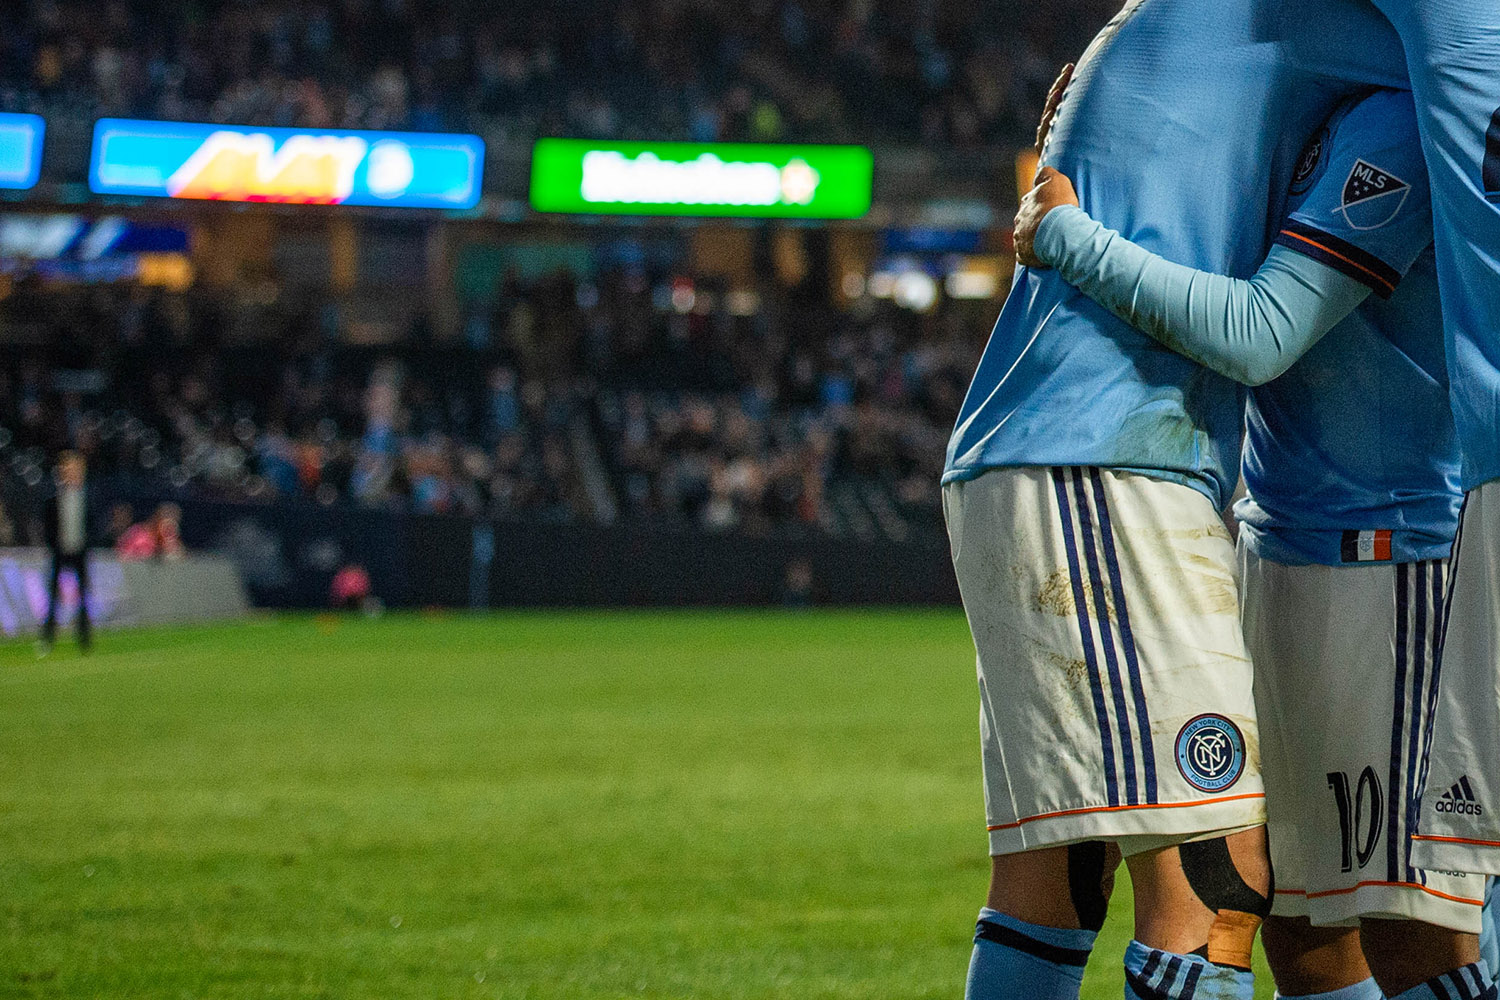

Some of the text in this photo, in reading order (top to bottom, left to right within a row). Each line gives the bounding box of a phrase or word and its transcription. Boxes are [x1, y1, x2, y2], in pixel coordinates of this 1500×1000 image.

[1354, 164, 1387, 189] MLS
[1185, 718, 1232, 737] NEW YORK CITY
[1190, 769, 1236, 788] FOOTBALL CLUB
[1435, 800, 1482, 816] adidas
[1326, 764, 1384, 873] 10
